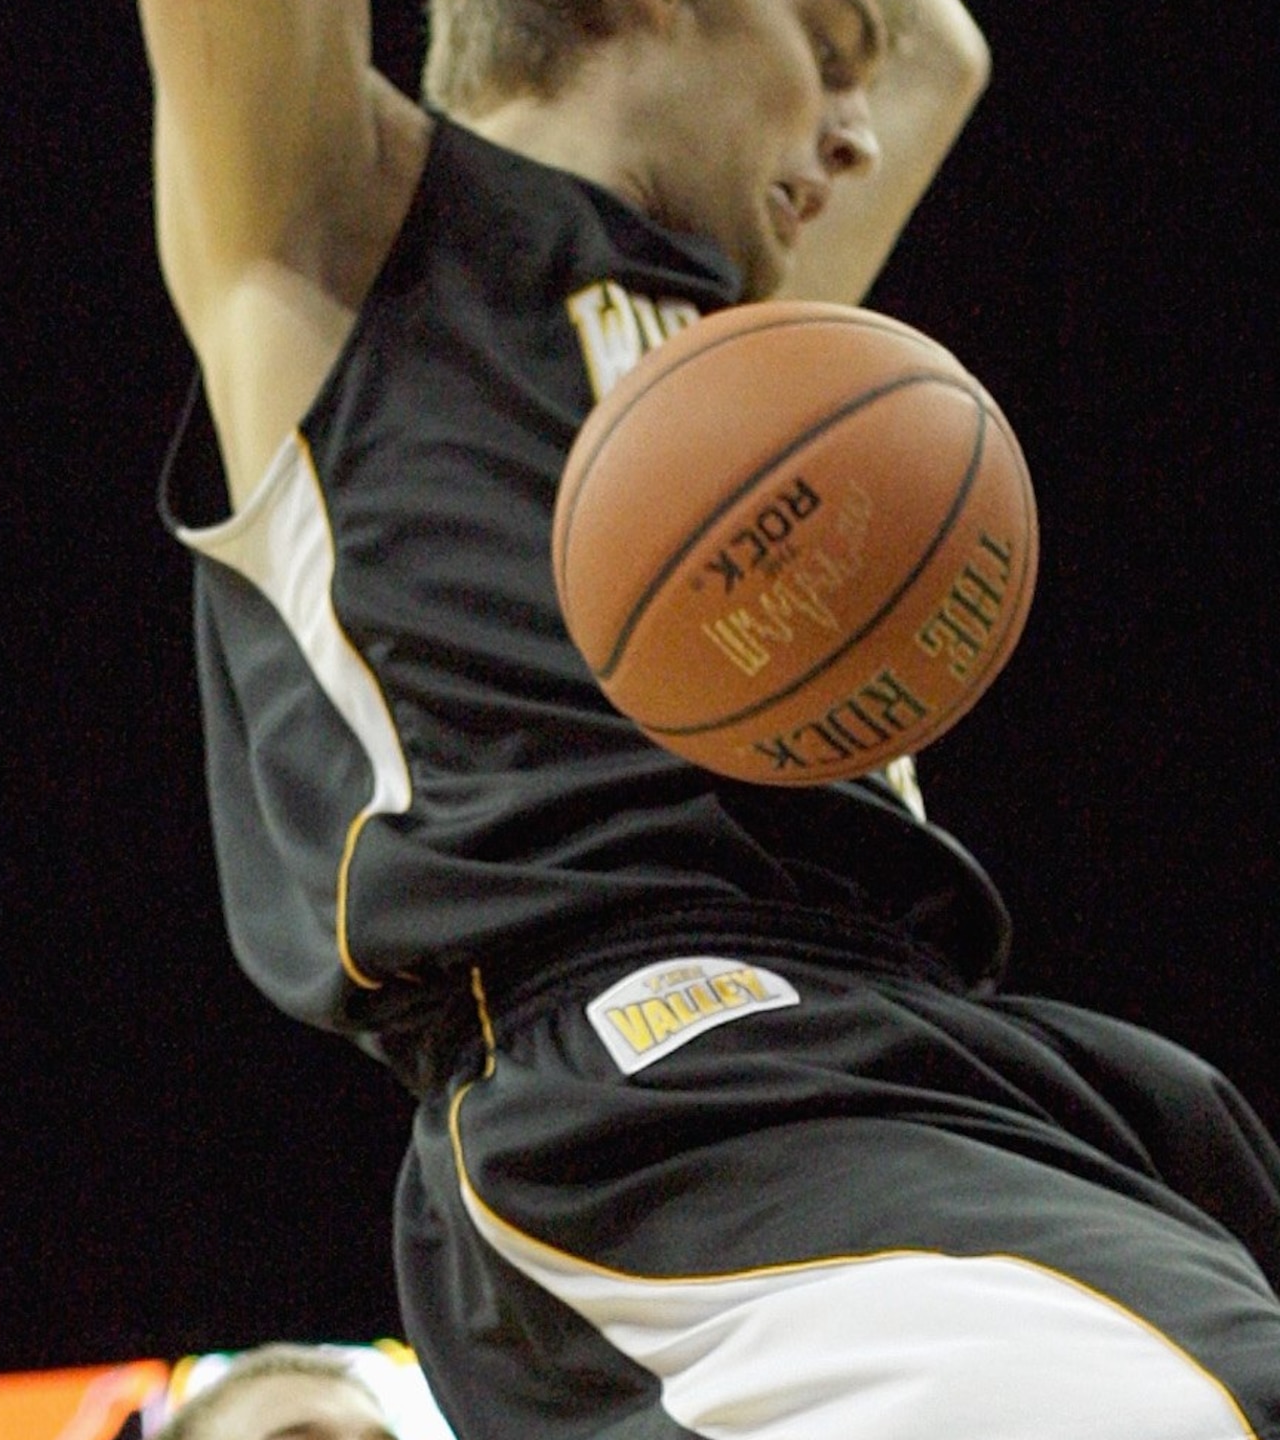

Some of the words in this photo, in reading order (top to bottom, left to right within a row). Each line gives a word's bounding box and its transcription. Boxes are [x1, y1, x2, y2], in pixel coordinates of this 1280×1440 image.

[708, 478, 819, 596] ROCK
[915, 530, 1013, 680] THE
[746, 665, 928, 774] ROCK
[606, 964, 770, 1056] VALLEY
